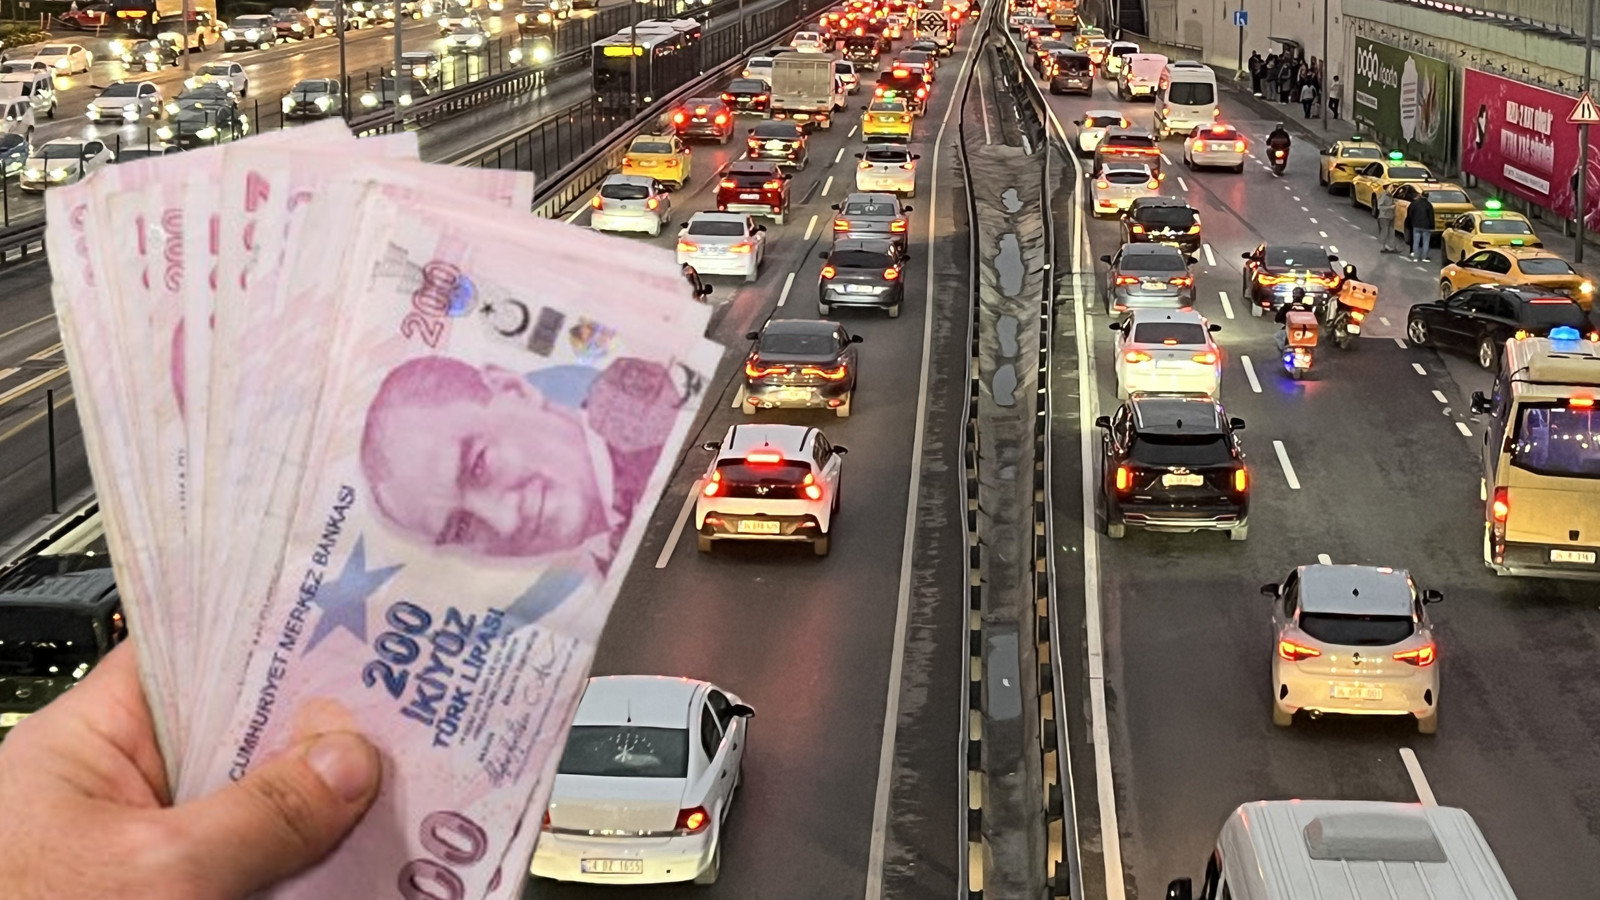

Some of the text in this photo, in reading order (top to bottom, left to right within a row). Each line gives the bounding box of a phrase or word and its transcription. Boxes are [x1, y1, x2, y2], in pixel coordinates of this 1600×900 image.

[400, 260, 462, 348] 200
[228, 651, 288, 782] CUMHURİYET
[279, 568, 323, 651] MERKEZ
[313, 485, 355, 567] BANKASI
[362, 601, 432, 700] 200
[400, 606, 477, 726] İKİYÜZ
[433, 686, 473, 747] TÜRK
[461, 607, 506, 683] LİRASI
